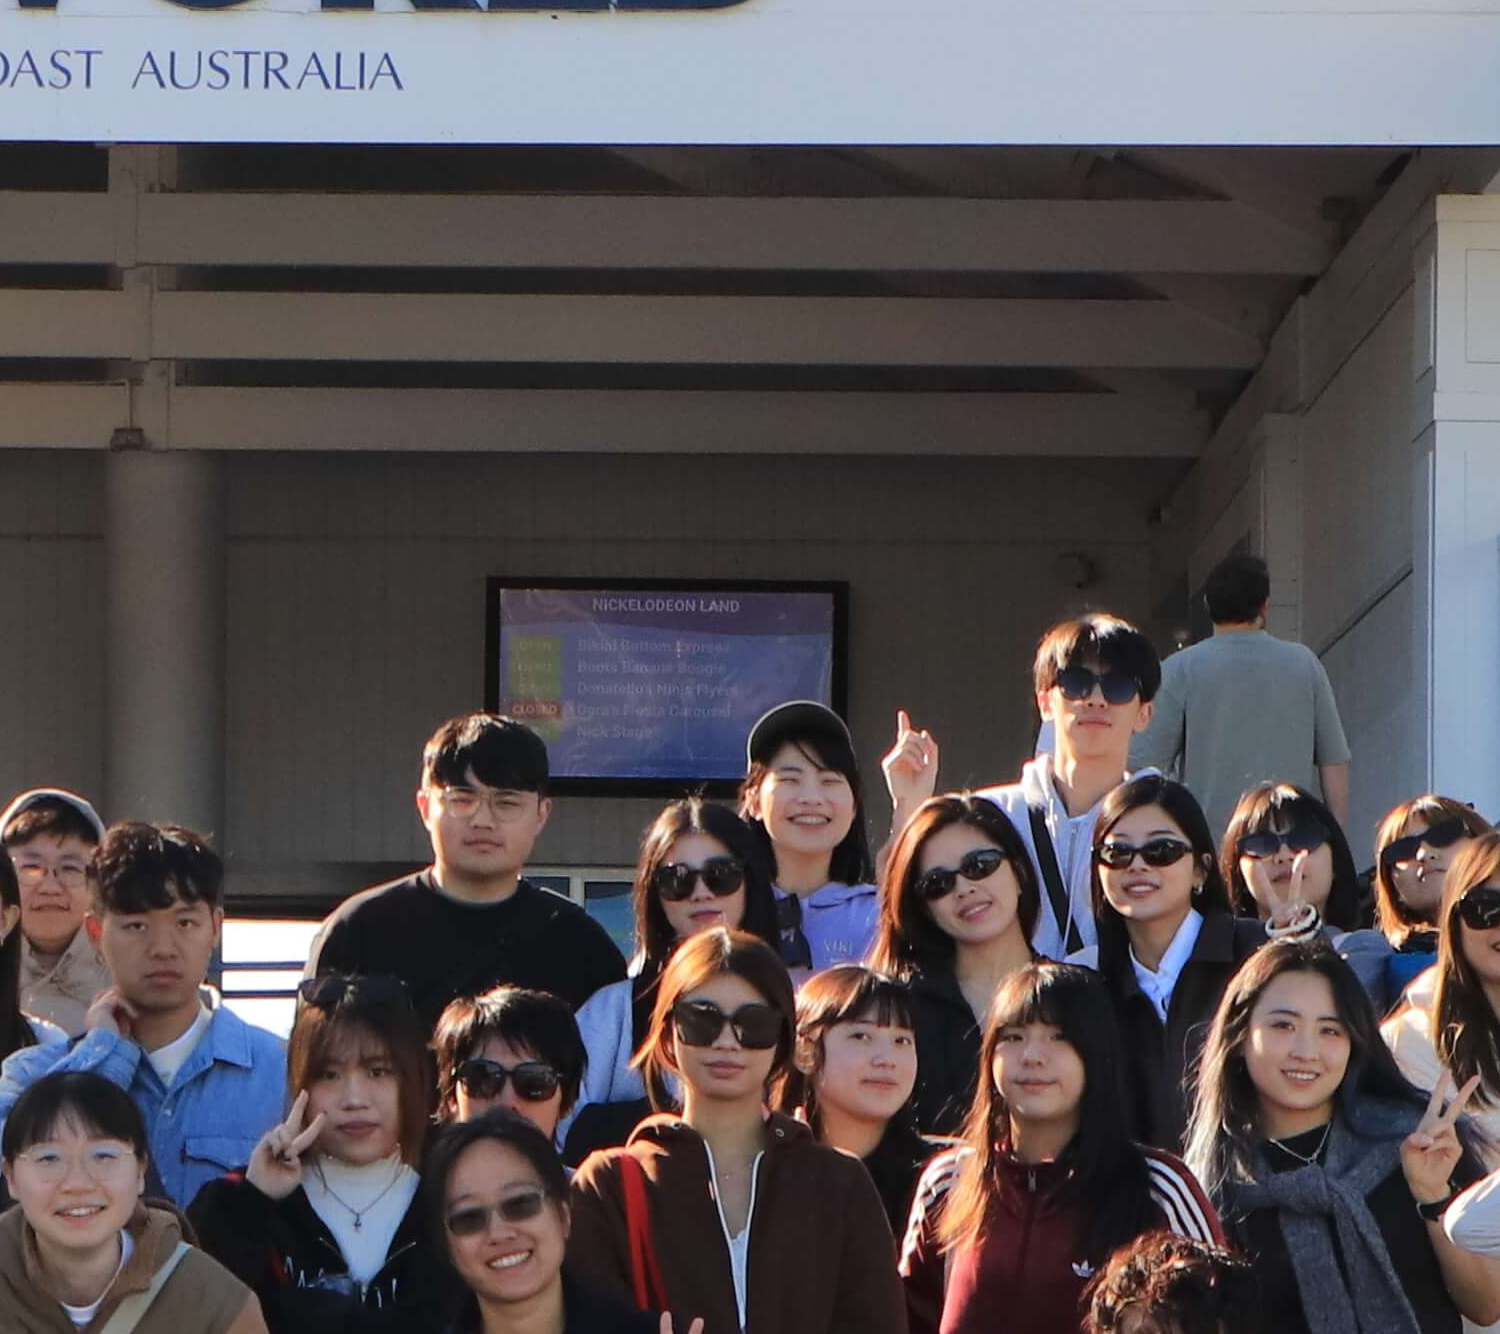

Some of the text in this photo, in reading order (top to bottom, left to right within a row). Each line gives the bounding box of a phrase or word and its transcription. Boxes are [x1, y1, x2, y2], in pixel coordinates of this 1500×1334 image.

[131, 49, 404, 91] AUSTRALIA
[592, 598, 740, 613] NICKELODEON LAND
[620, 640, 673, 652] Bottom
[577, 726, 607, 738] Nick
